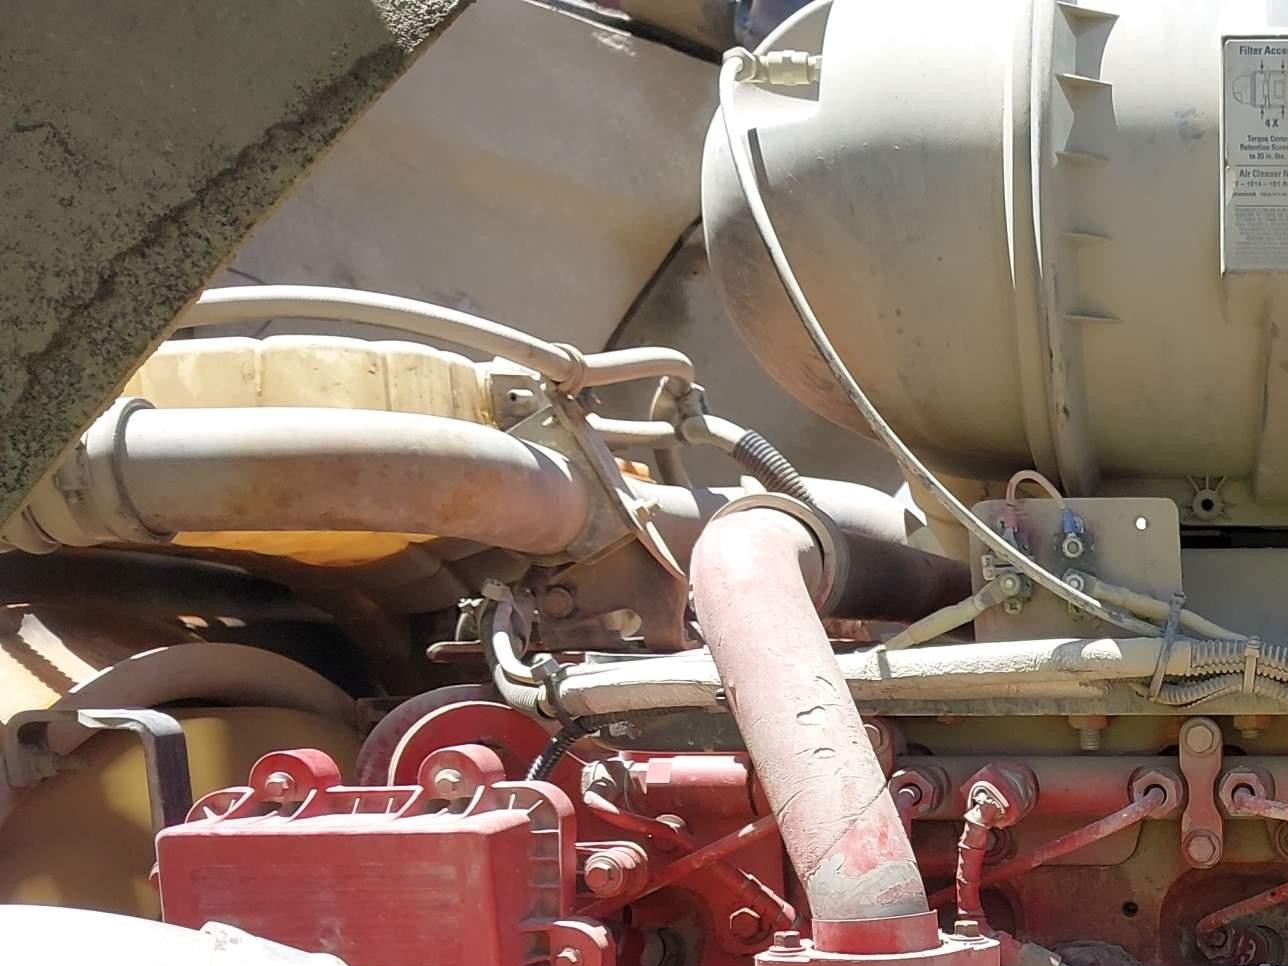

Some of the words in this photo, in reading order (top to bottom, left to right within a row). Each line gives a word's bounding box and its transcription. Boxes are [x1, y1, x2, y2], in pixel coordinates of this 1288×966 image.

[1240, 46, 1262, 55] Filter
[1265, 119, 1271, 128] 4
[1272, 119, 1279, 128] X
[1240, 169, 1251, 178] Air
[1252, 169, 1282, 178] Cleaner
